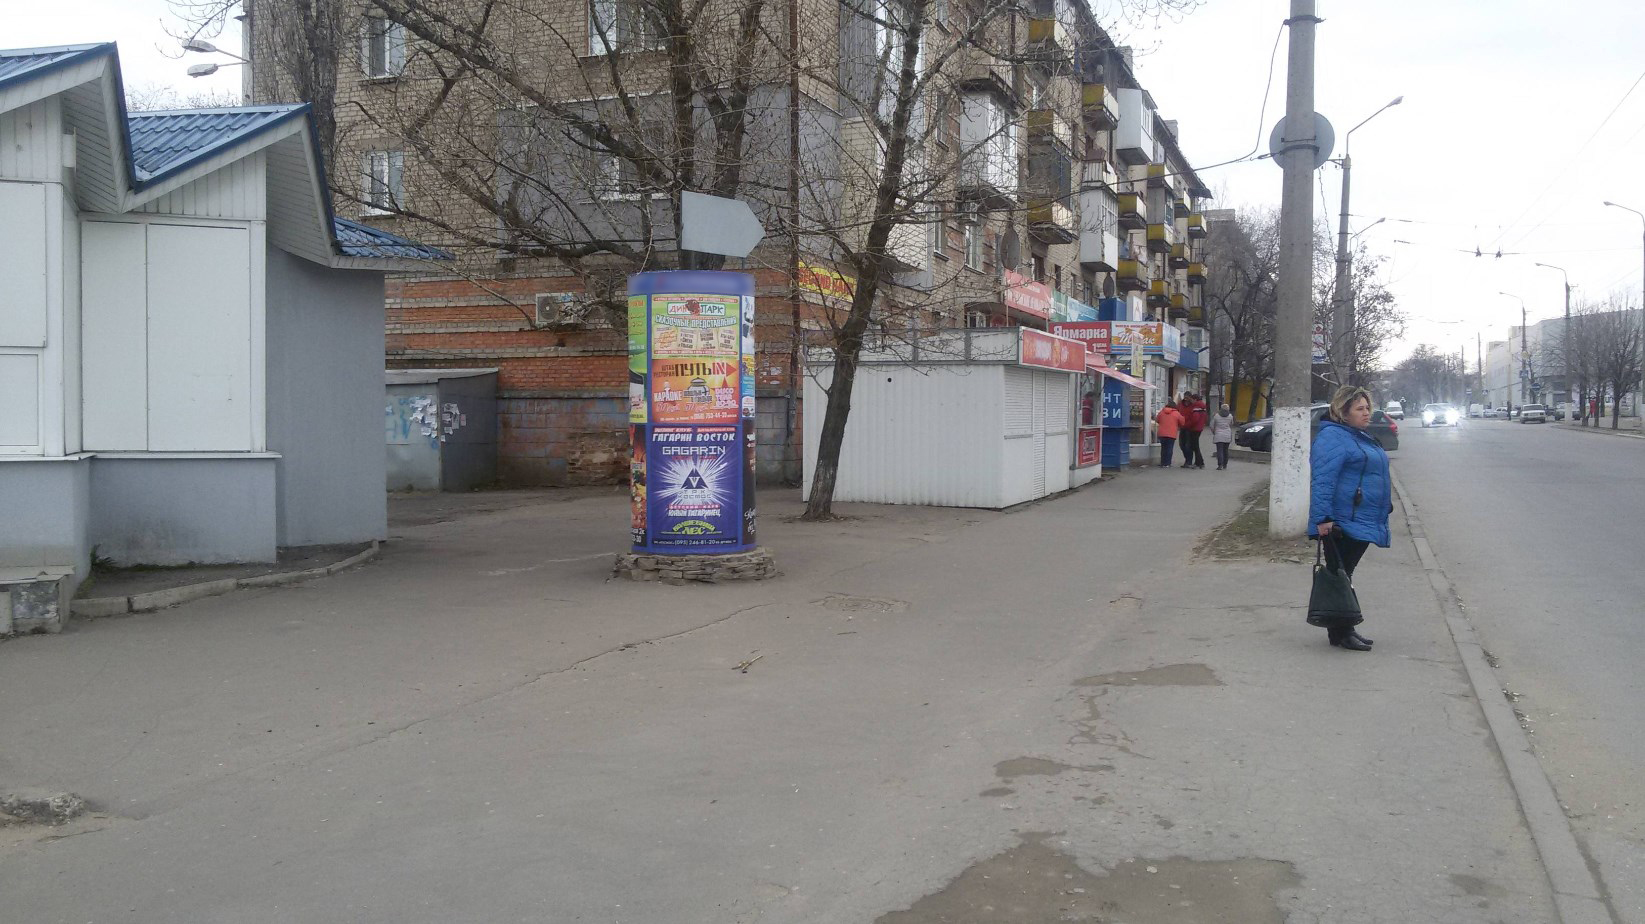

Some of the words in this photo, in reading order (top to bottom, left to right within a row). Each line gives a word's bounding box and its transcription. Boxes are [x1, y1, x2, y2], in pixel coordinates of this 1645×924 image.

[1053, 326, 1107, 341] Ярмарка
[652, 433, 692, 442] ГАГАРИН
[696, 433, 736, 442] ВОСТОК
[662, 445, 726, 455] GAGARIN
[682, 526, 705, 535] ЛЕС
